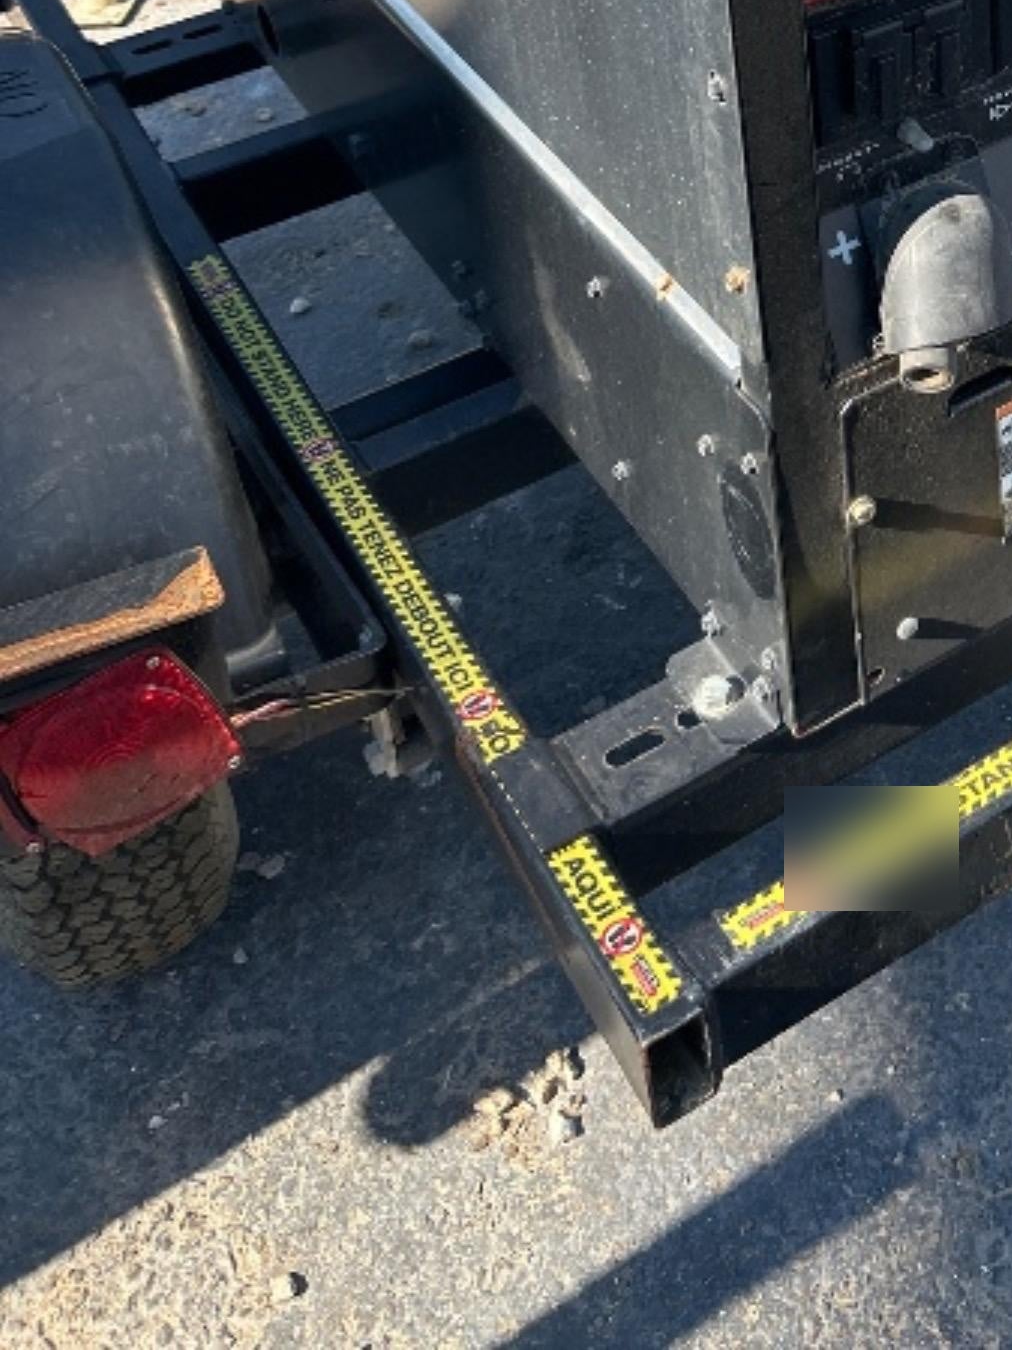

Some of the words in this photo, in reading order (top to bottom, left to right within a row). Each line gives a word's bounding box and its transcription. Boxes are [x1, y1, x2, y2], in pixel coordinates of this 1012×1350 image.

[340, 484, 367, 520] PAS
[359, 518, 406, 579] TENEZ
[394, 578, 457, 659] DEBOUT
[444, 660, 475, 692] ICI
